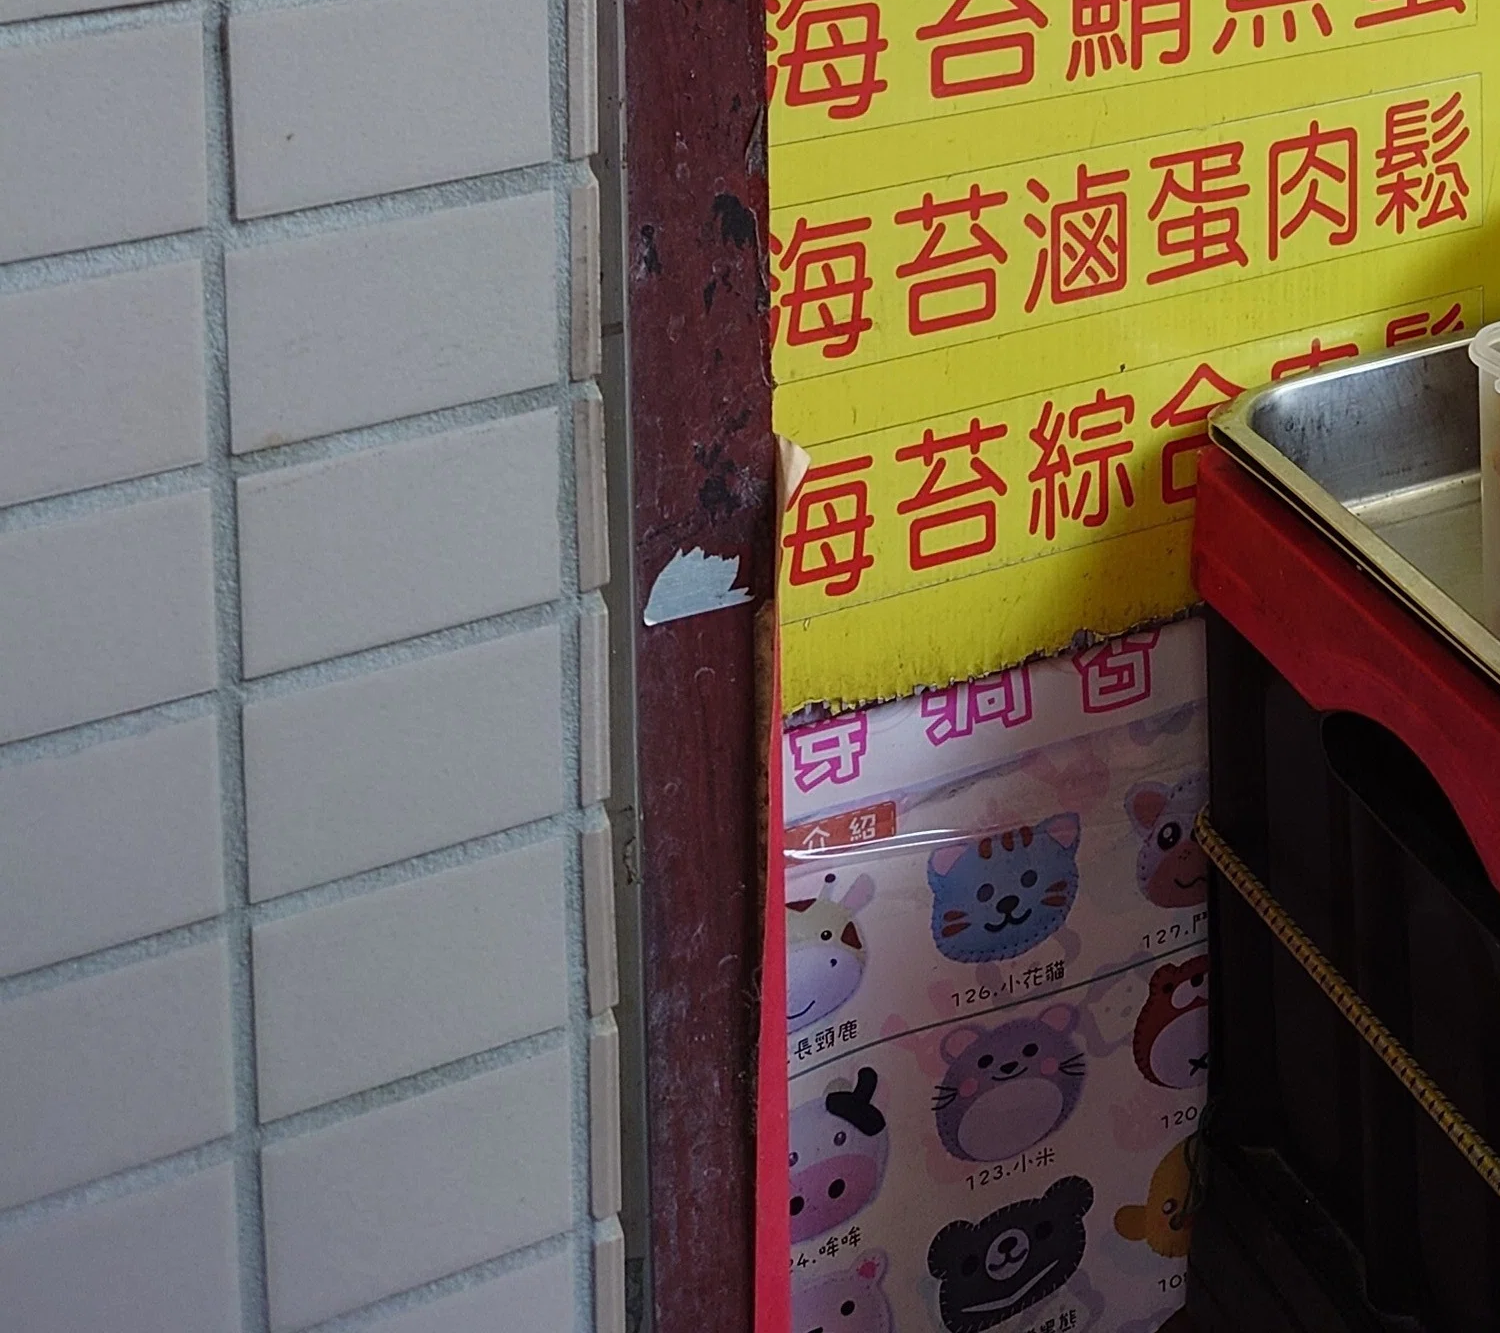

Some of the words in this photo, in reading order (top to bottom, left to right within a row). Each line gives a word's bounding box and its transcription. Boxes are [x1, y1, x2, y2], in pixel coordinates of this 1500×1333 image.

[768, 93, 1469, 363] 海苔滷蛋肉鬆
[782, 304, 1464, 586] 海苔綜合
[951, 959, 1066, 1008] 126.小花貓
[966, 1146, 1056, 1191] 123.小米
